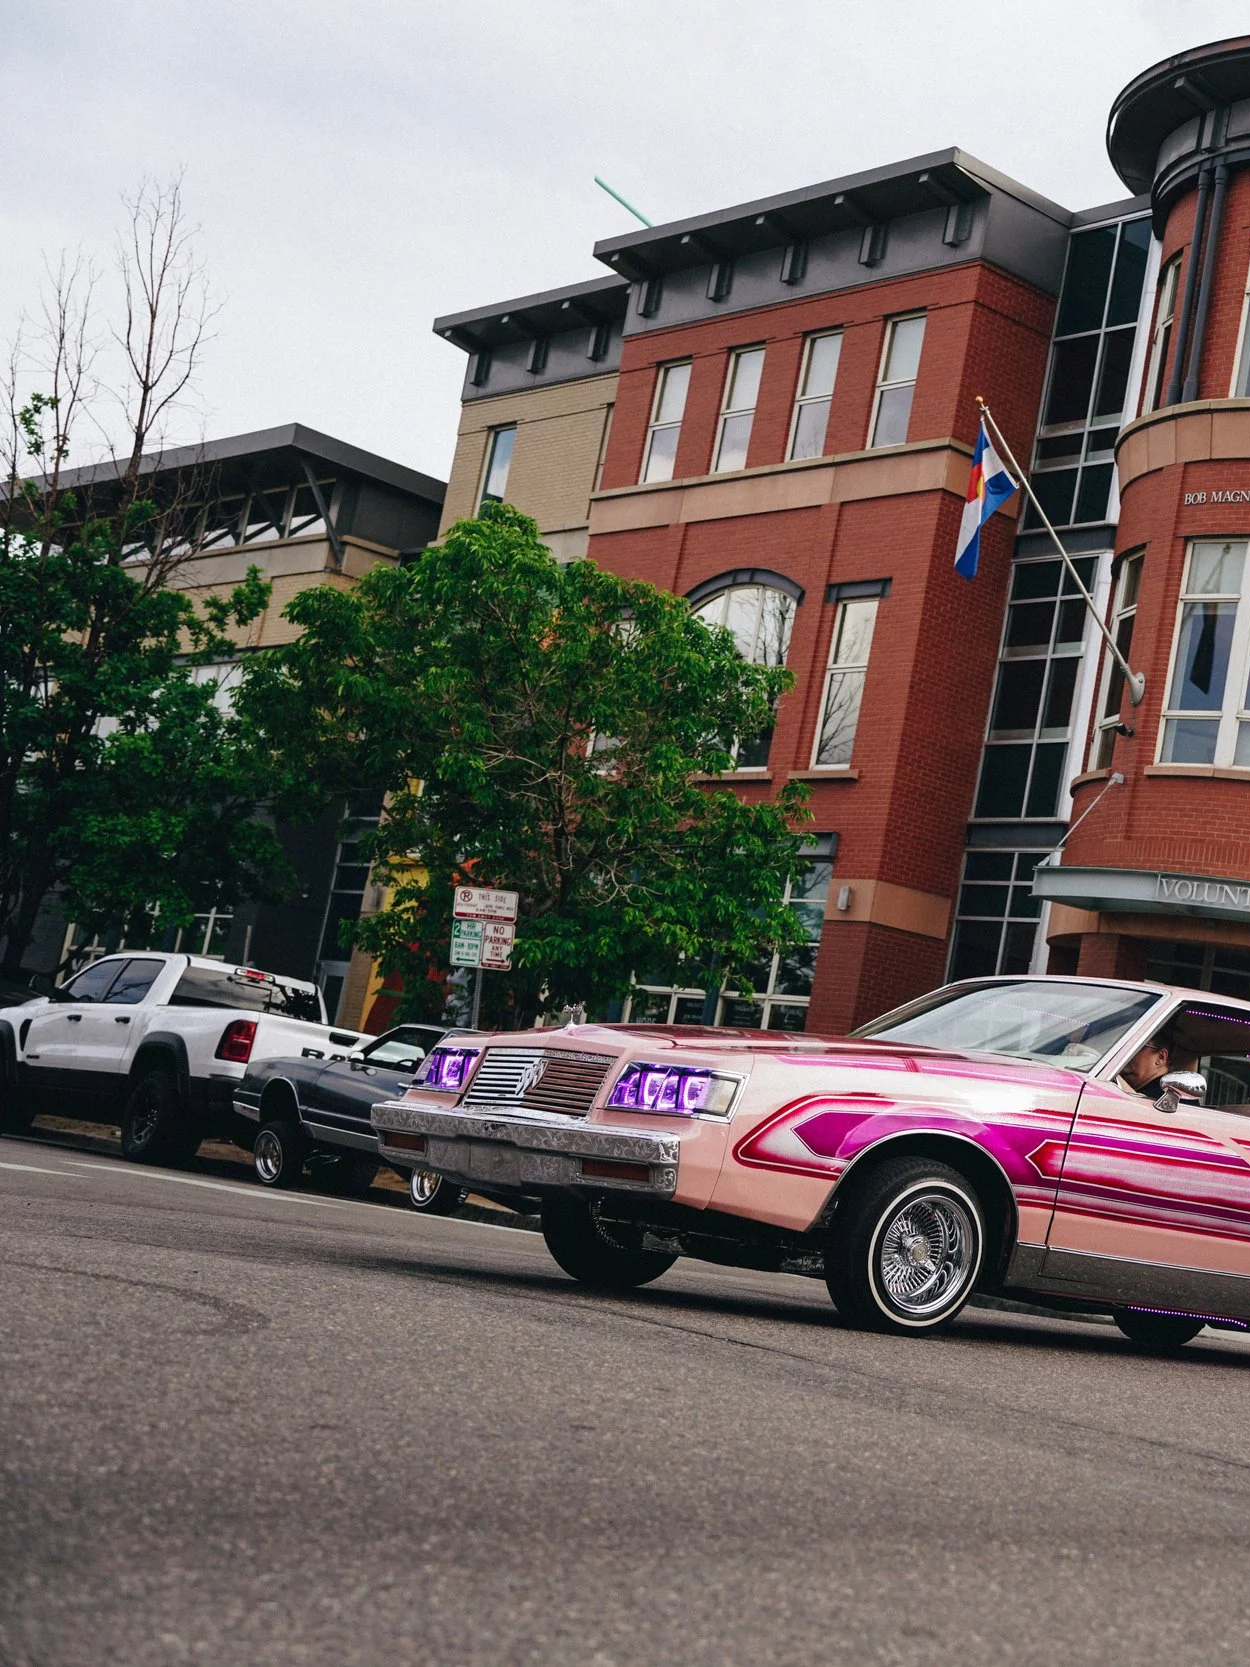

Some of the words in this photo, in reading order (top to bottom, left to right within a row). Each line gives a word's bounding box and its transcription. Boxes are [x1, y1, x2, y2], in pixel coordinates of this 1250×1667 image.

[1184, 492, 1207, 505] BOB
[454, 922, 460, 936] 2
[467, 922, 477, 930] HR
[460, 929, 482, 938] PARKING
[493, 926, 505, 935] NO
[485, 935, 511, 946] PARKING
